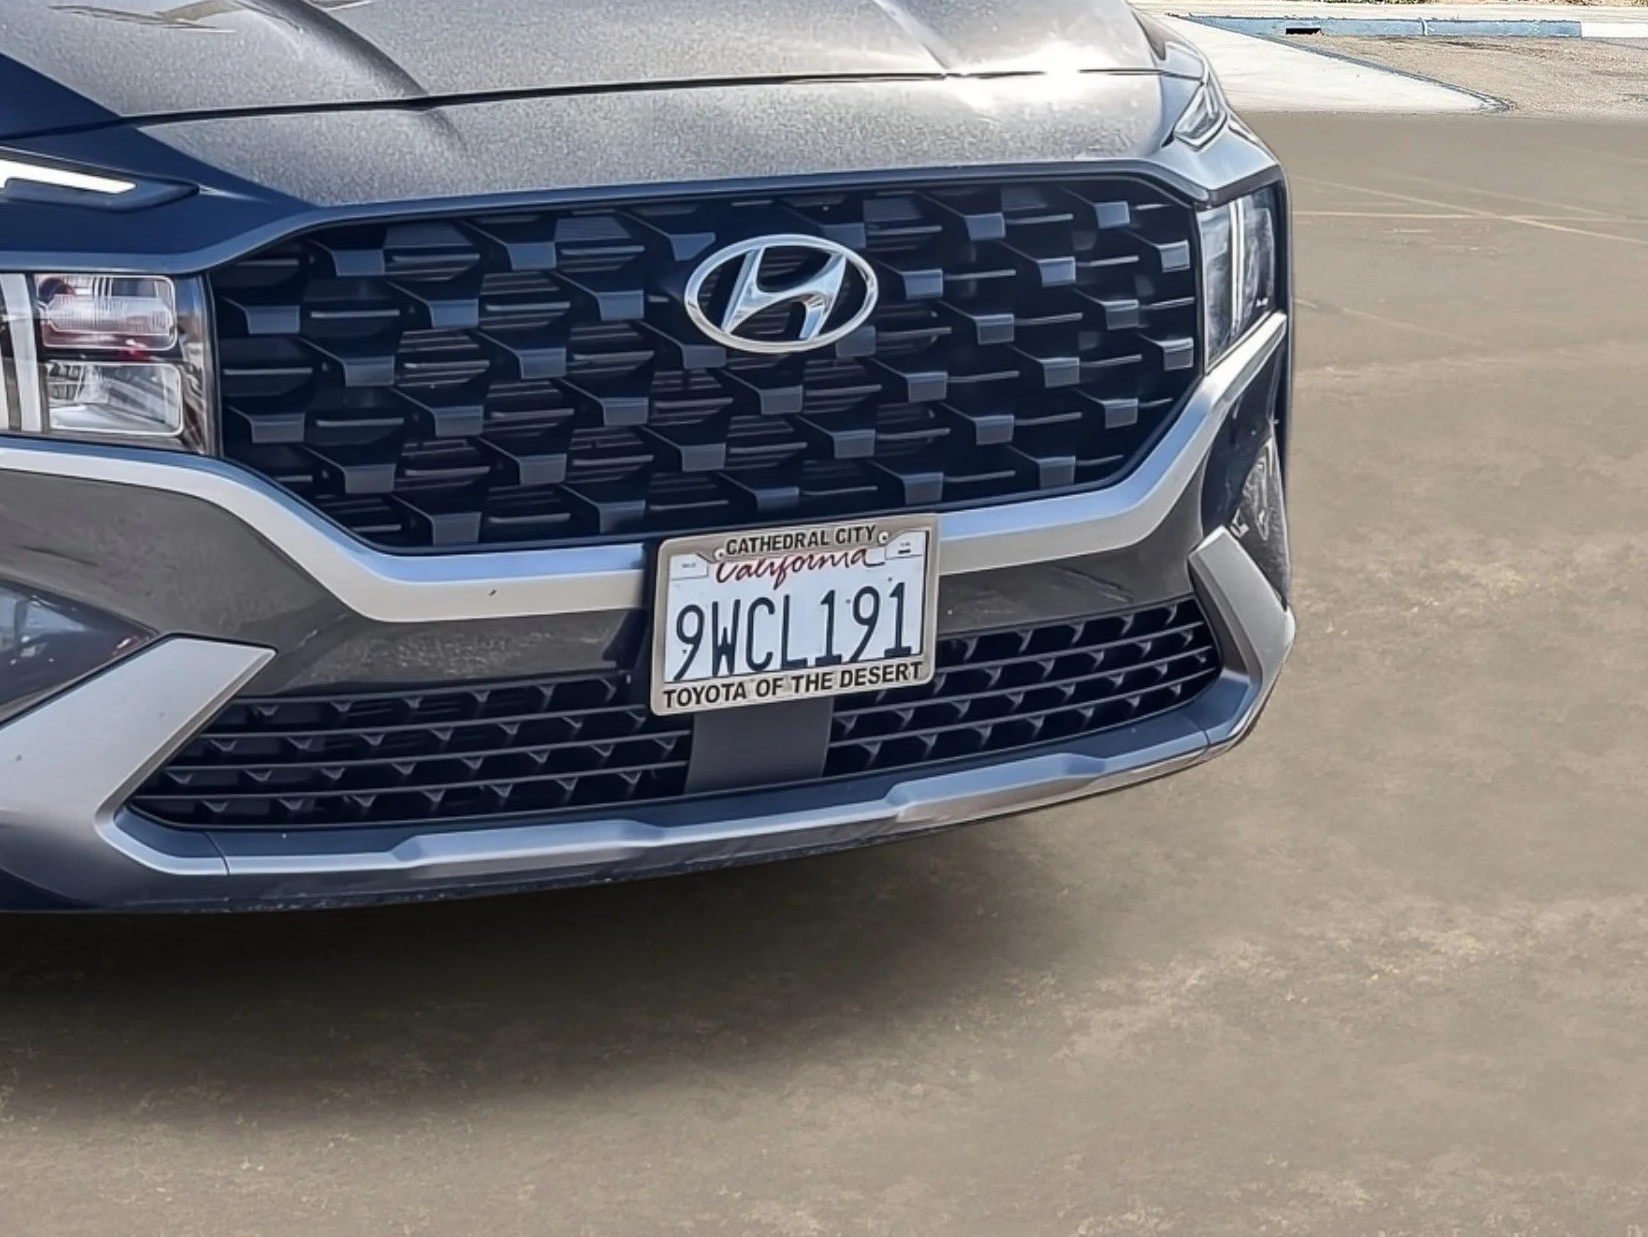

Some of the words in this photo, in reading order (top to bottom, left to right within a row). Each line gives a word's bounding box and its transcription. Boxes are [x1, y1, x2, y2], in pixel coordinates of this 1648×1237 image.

[725, 531, 829, 555] CATHEDRAL
[835, 524, 876, 545] CITY
[672, 581, 912, 682] 9WCL191
[663, 682, 747, 709] TOYOTA
[755, 677, 778, 698] OF
[791, 671, 833, 693] THE
[838, 661, 923, 688] DESERT
